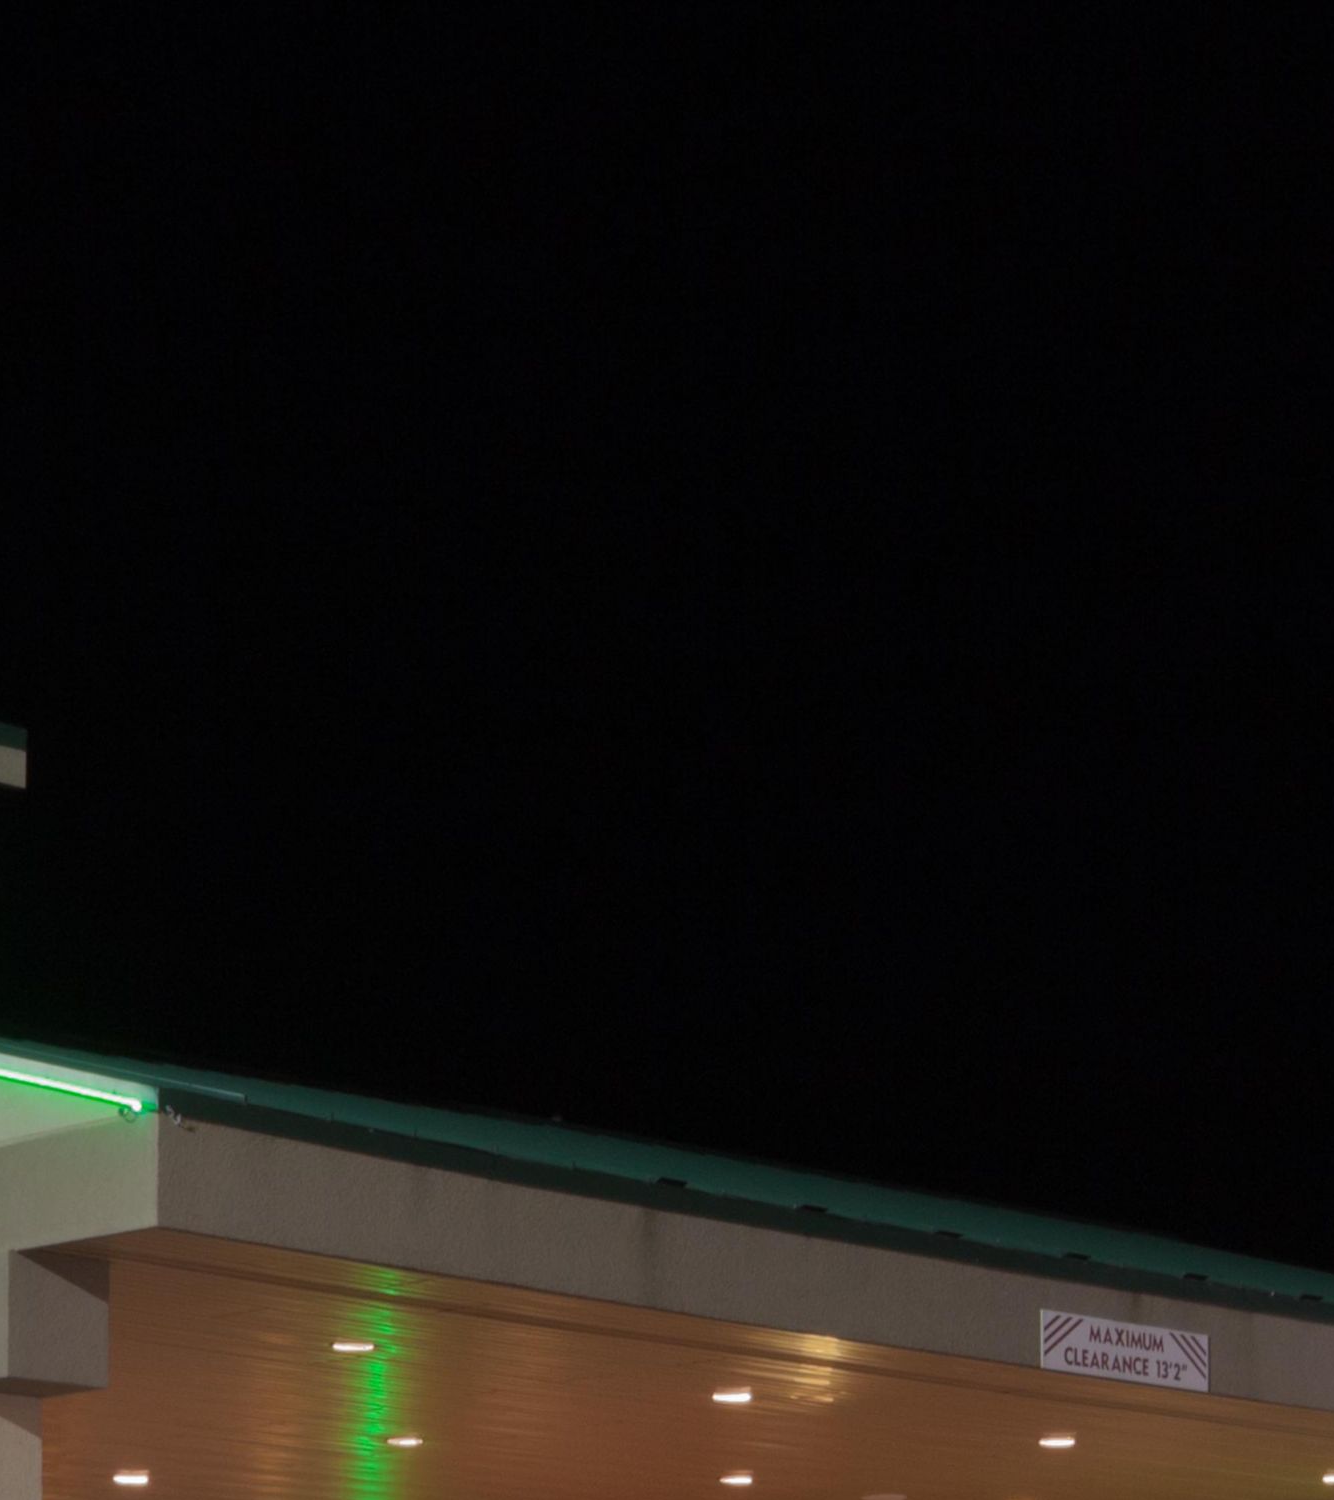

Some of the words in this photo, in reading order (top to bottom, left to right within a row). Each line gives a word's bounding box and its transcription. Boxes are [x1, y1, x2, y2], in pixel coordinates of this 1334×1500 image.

[1088, 1325, 1165, 1352] MAXIMUM
[1064, 1347, 1149, 1376] CLEARANCE
[1156, 1360, 1188, 1381] 13'2"
